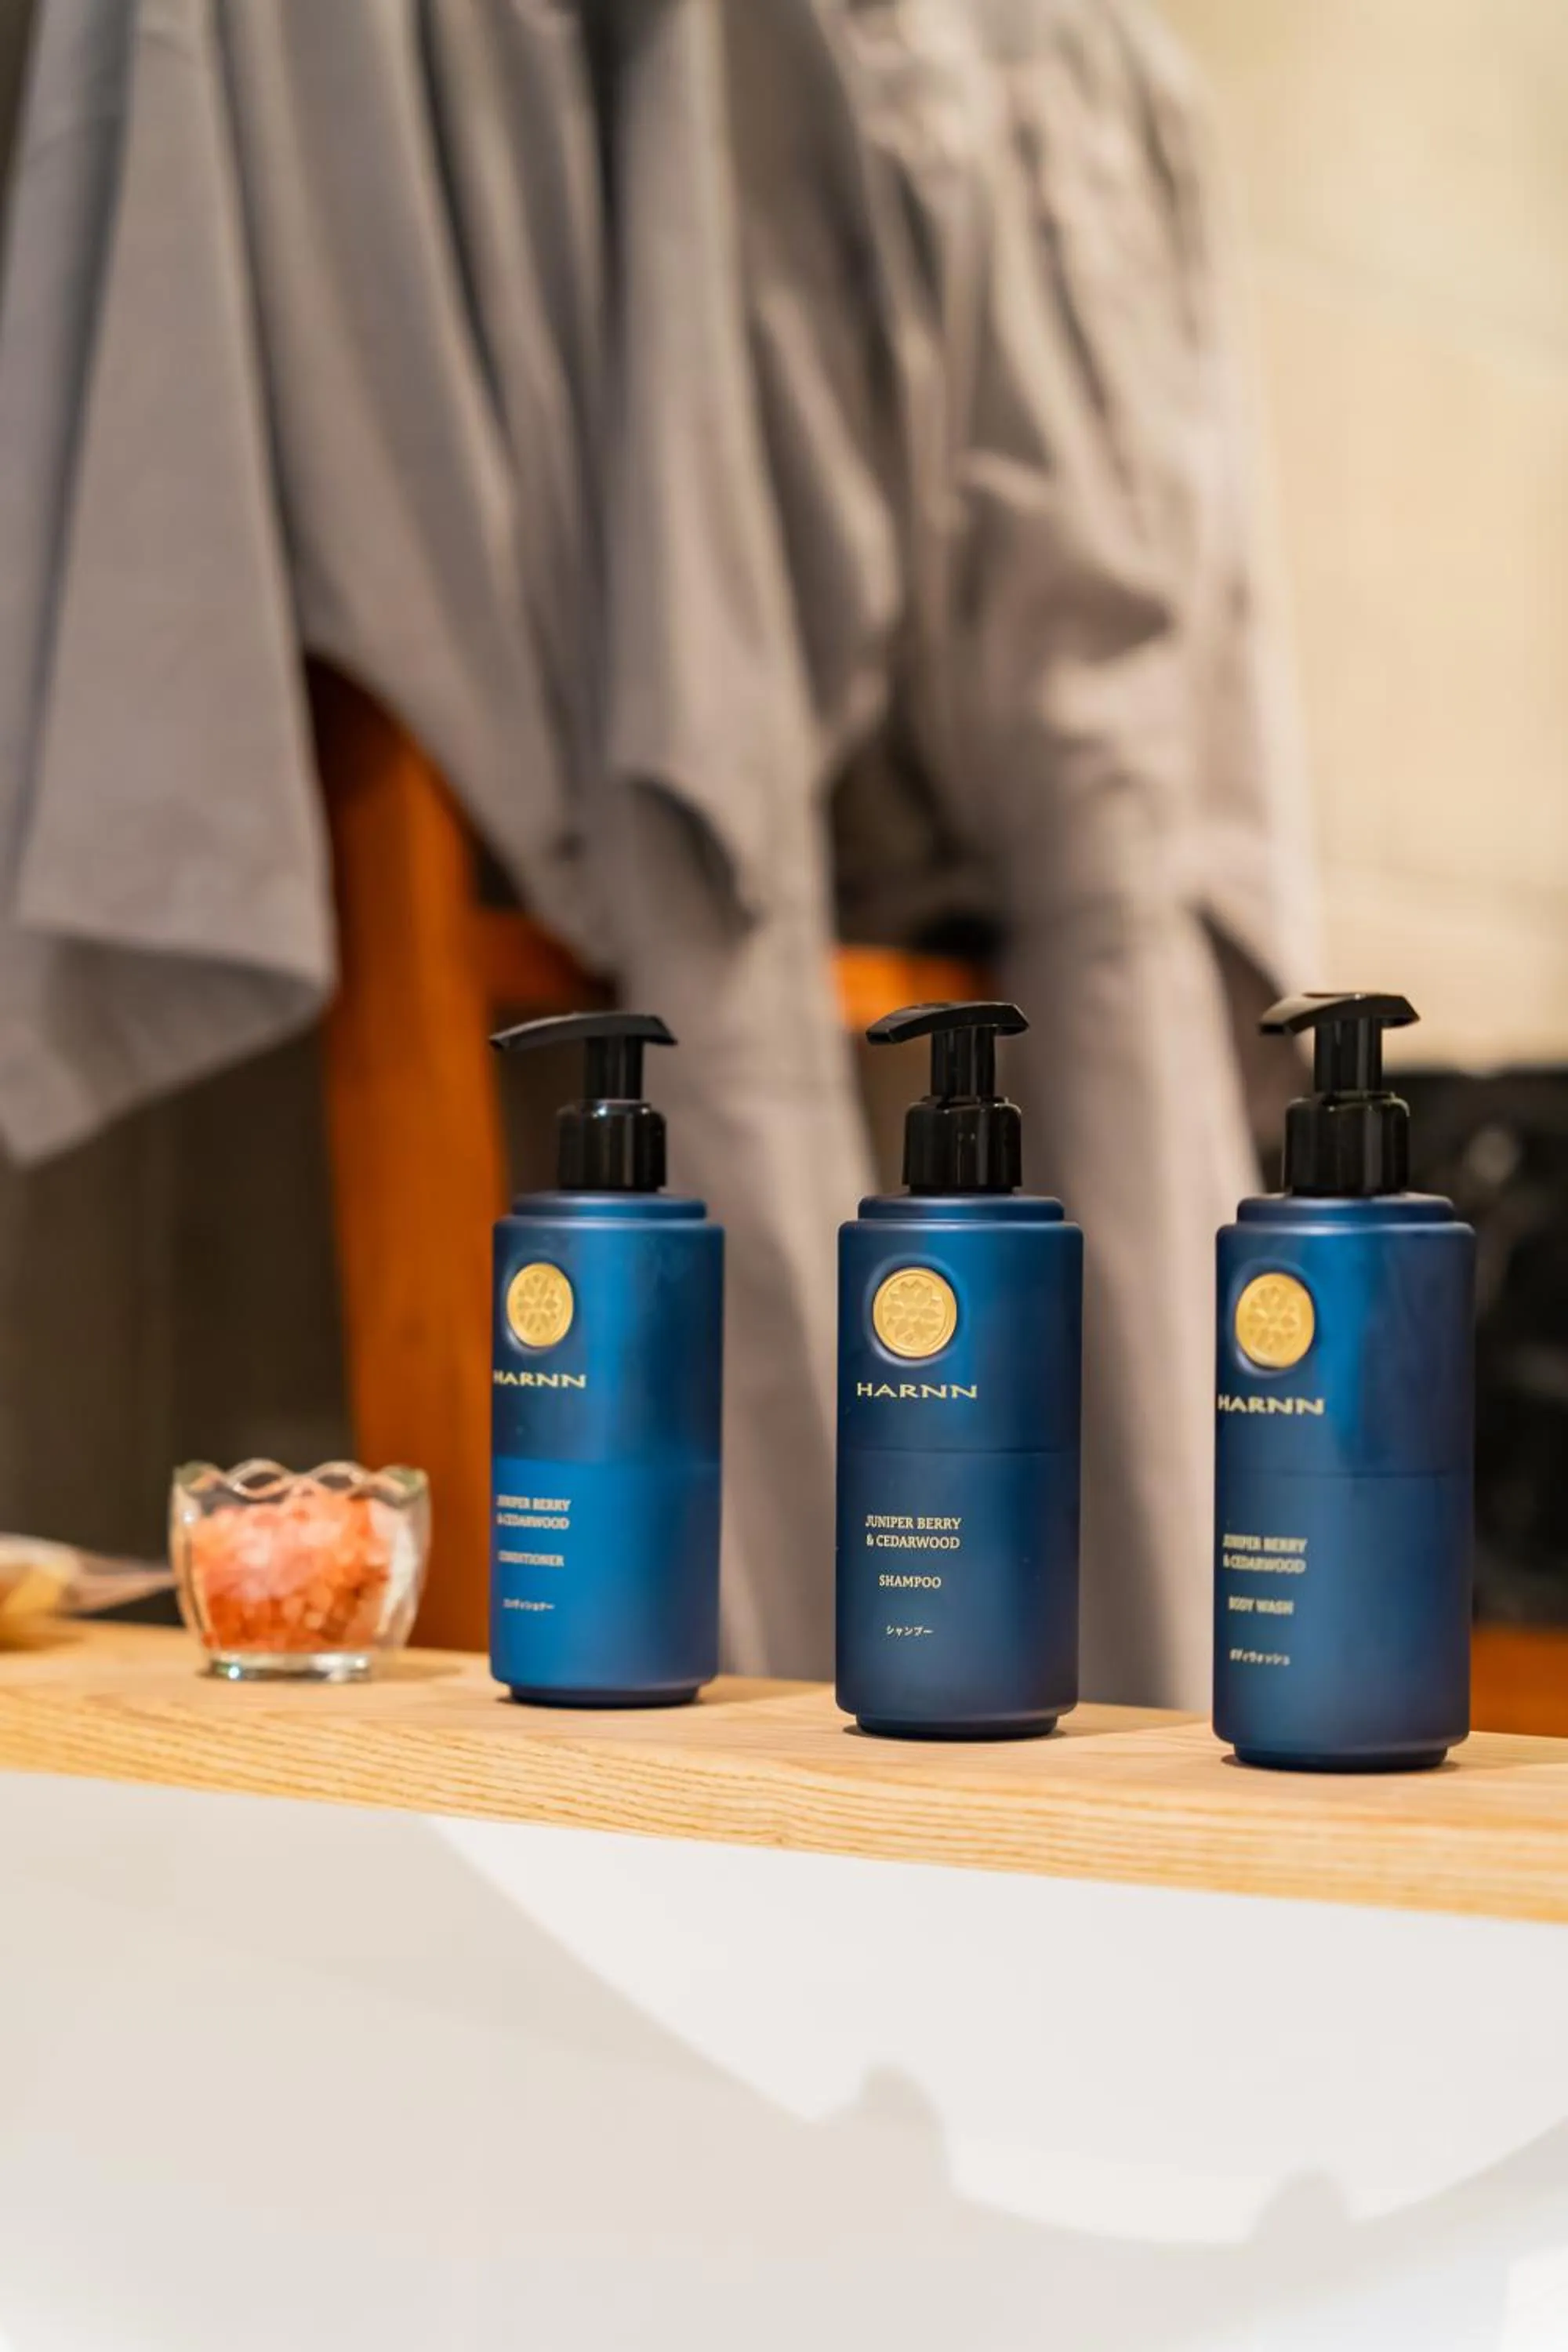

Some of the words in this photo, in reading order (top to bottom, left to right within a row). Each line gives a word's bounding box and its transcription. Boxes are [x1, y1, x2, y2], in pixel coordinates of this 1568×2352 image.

[493, 1370, 586, 1388] HARNN
[857, 1382, 978, 1399] HARNN
[1218, 1395, 1325, 1416] HARNN
[865, 1515, 914, 1529] JUNIPER
[916, 1517, 962, 1530] BERRY
[866, 1533, 874, 1546] &
[876, 1534, 960, 1548] CEDARWOOD
[498, 1550, 564, 1567] CTIONER
[878, 1573, 942, 1589] SHAMPOO
[1255, 1599, 1294, 1616] WASH
[886, 1624, 935, 1638] シャンプー
